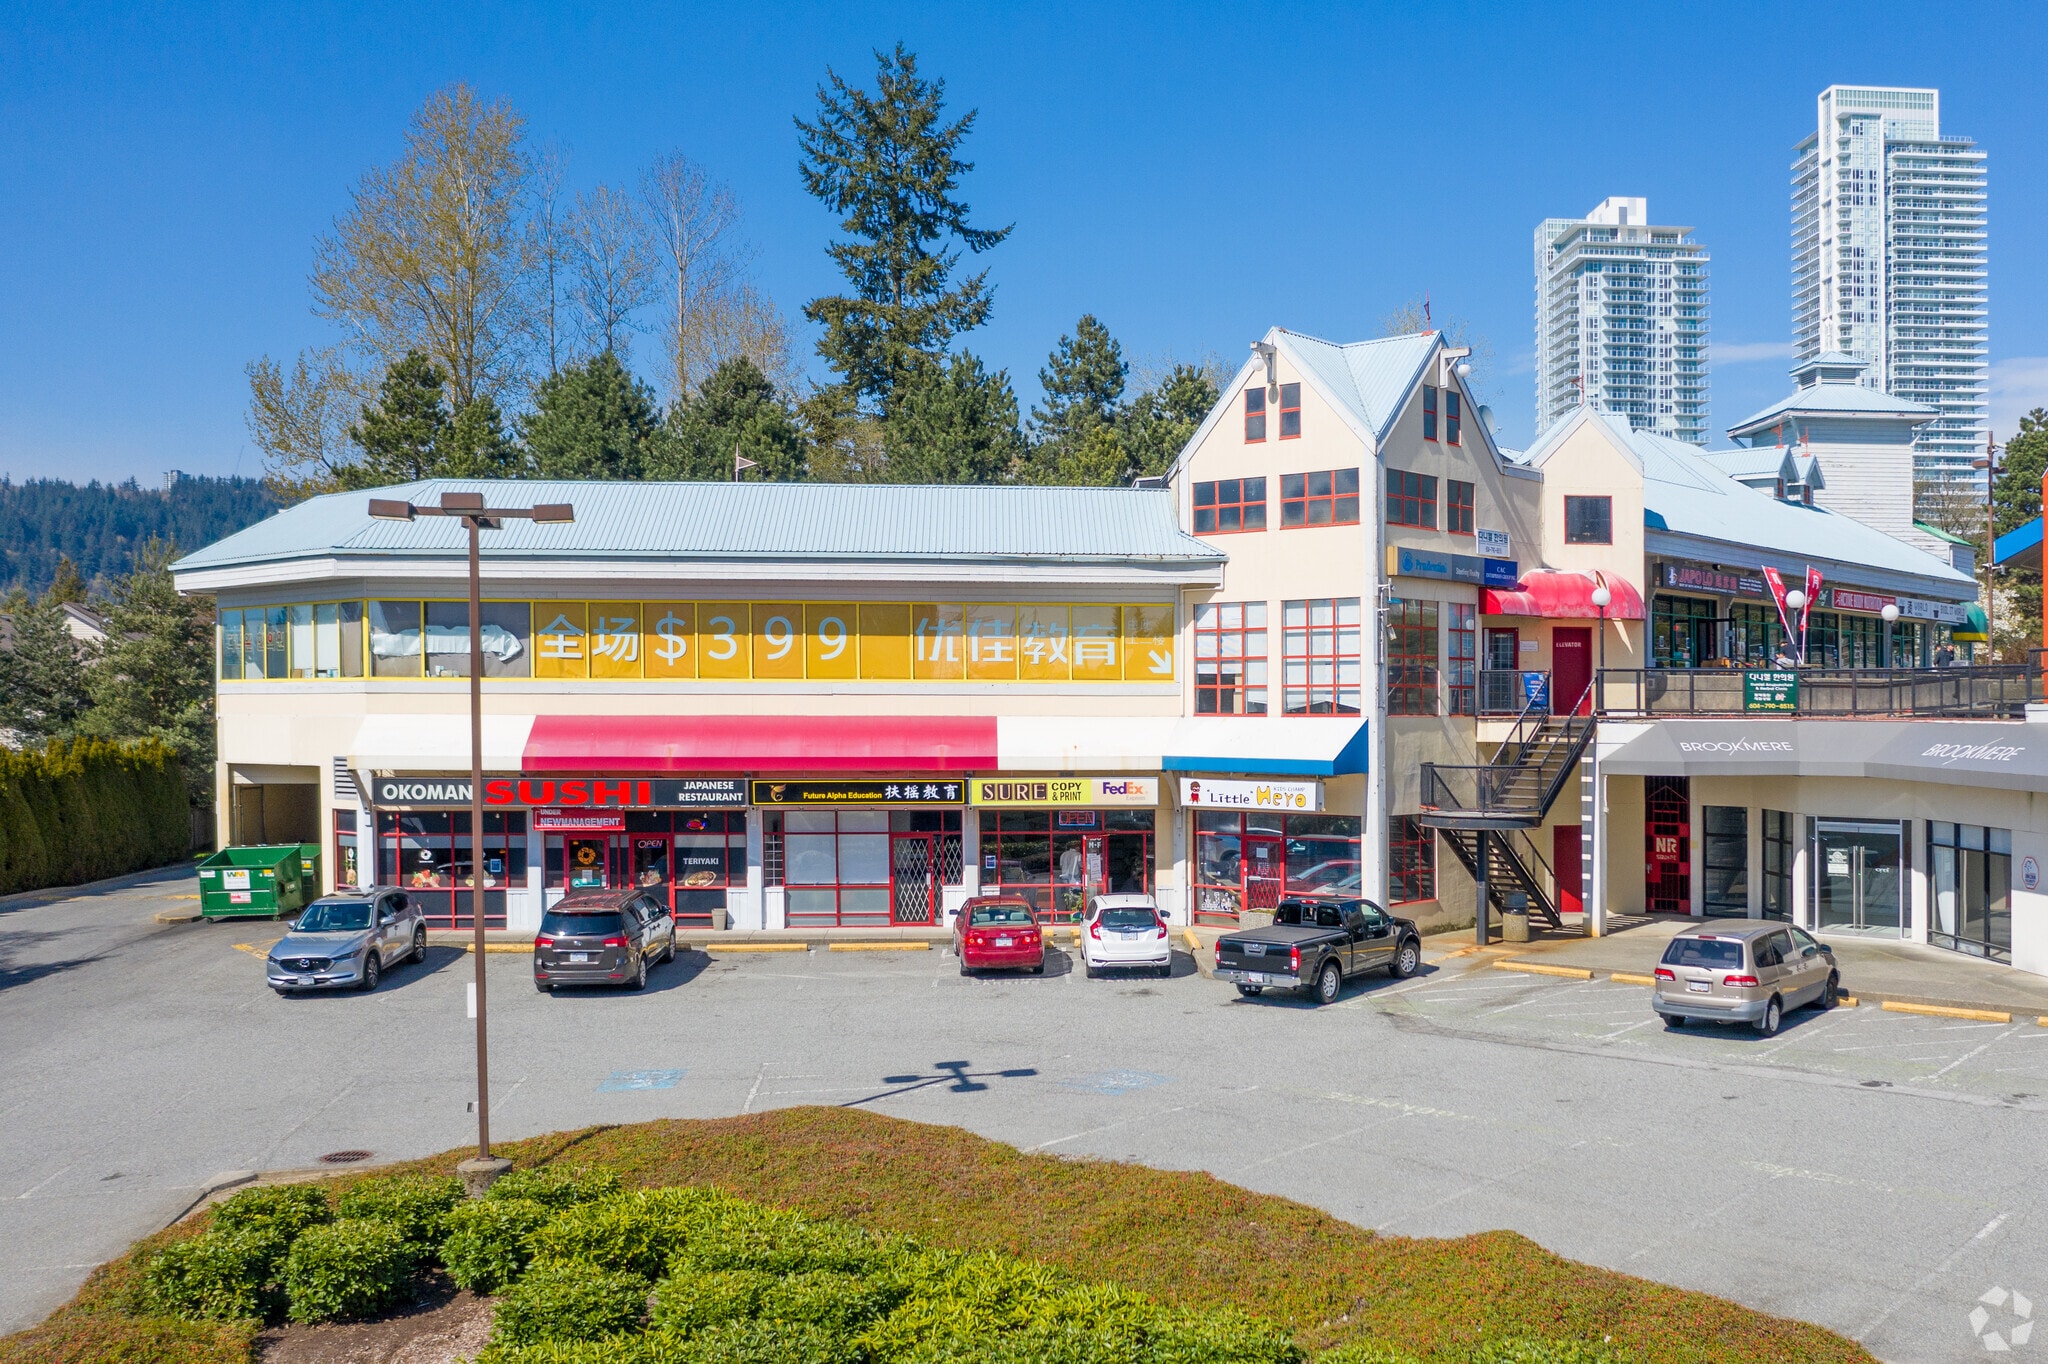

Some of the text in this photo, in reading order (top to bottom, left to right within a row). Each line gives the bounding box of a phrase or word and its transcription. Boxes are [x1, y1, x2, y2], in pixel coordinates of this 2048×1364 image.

[538, 613, 639, 662] 全场
[655, 611, 847, 666] $399
[915, 617, 1118, 666] 优佳教育
[1748, 673, 1795, 682] 다니엘 한의원
[1680, 738, 1793, 755] BROOKMERE
[1921, 738, 2026, 764] BROOKMERE
[485, 780, 651, 805] SUSHI
[683, 781, 734, 790] JAPANESE
[982, 783, 1047, 801] SURE
[1051, 782, 1082, 791] COPY
[1103, 781, 1143, 795] FedEx
[678, 793, 743, 802] RESTAURANT
[826, 792, 847, 800] Alpha
[848, 791, 882, 799] Education
[1052, 792, 1082, 801] & PRINT
[1256, 785, 1307, 808] Hero
[1059, 811, 1094, 825] OPEN
[637, 840, 663, 848] OPEN
[1656, 837, 1677, 853] NR
[683, 857, 719, 865] TERIYAKI
